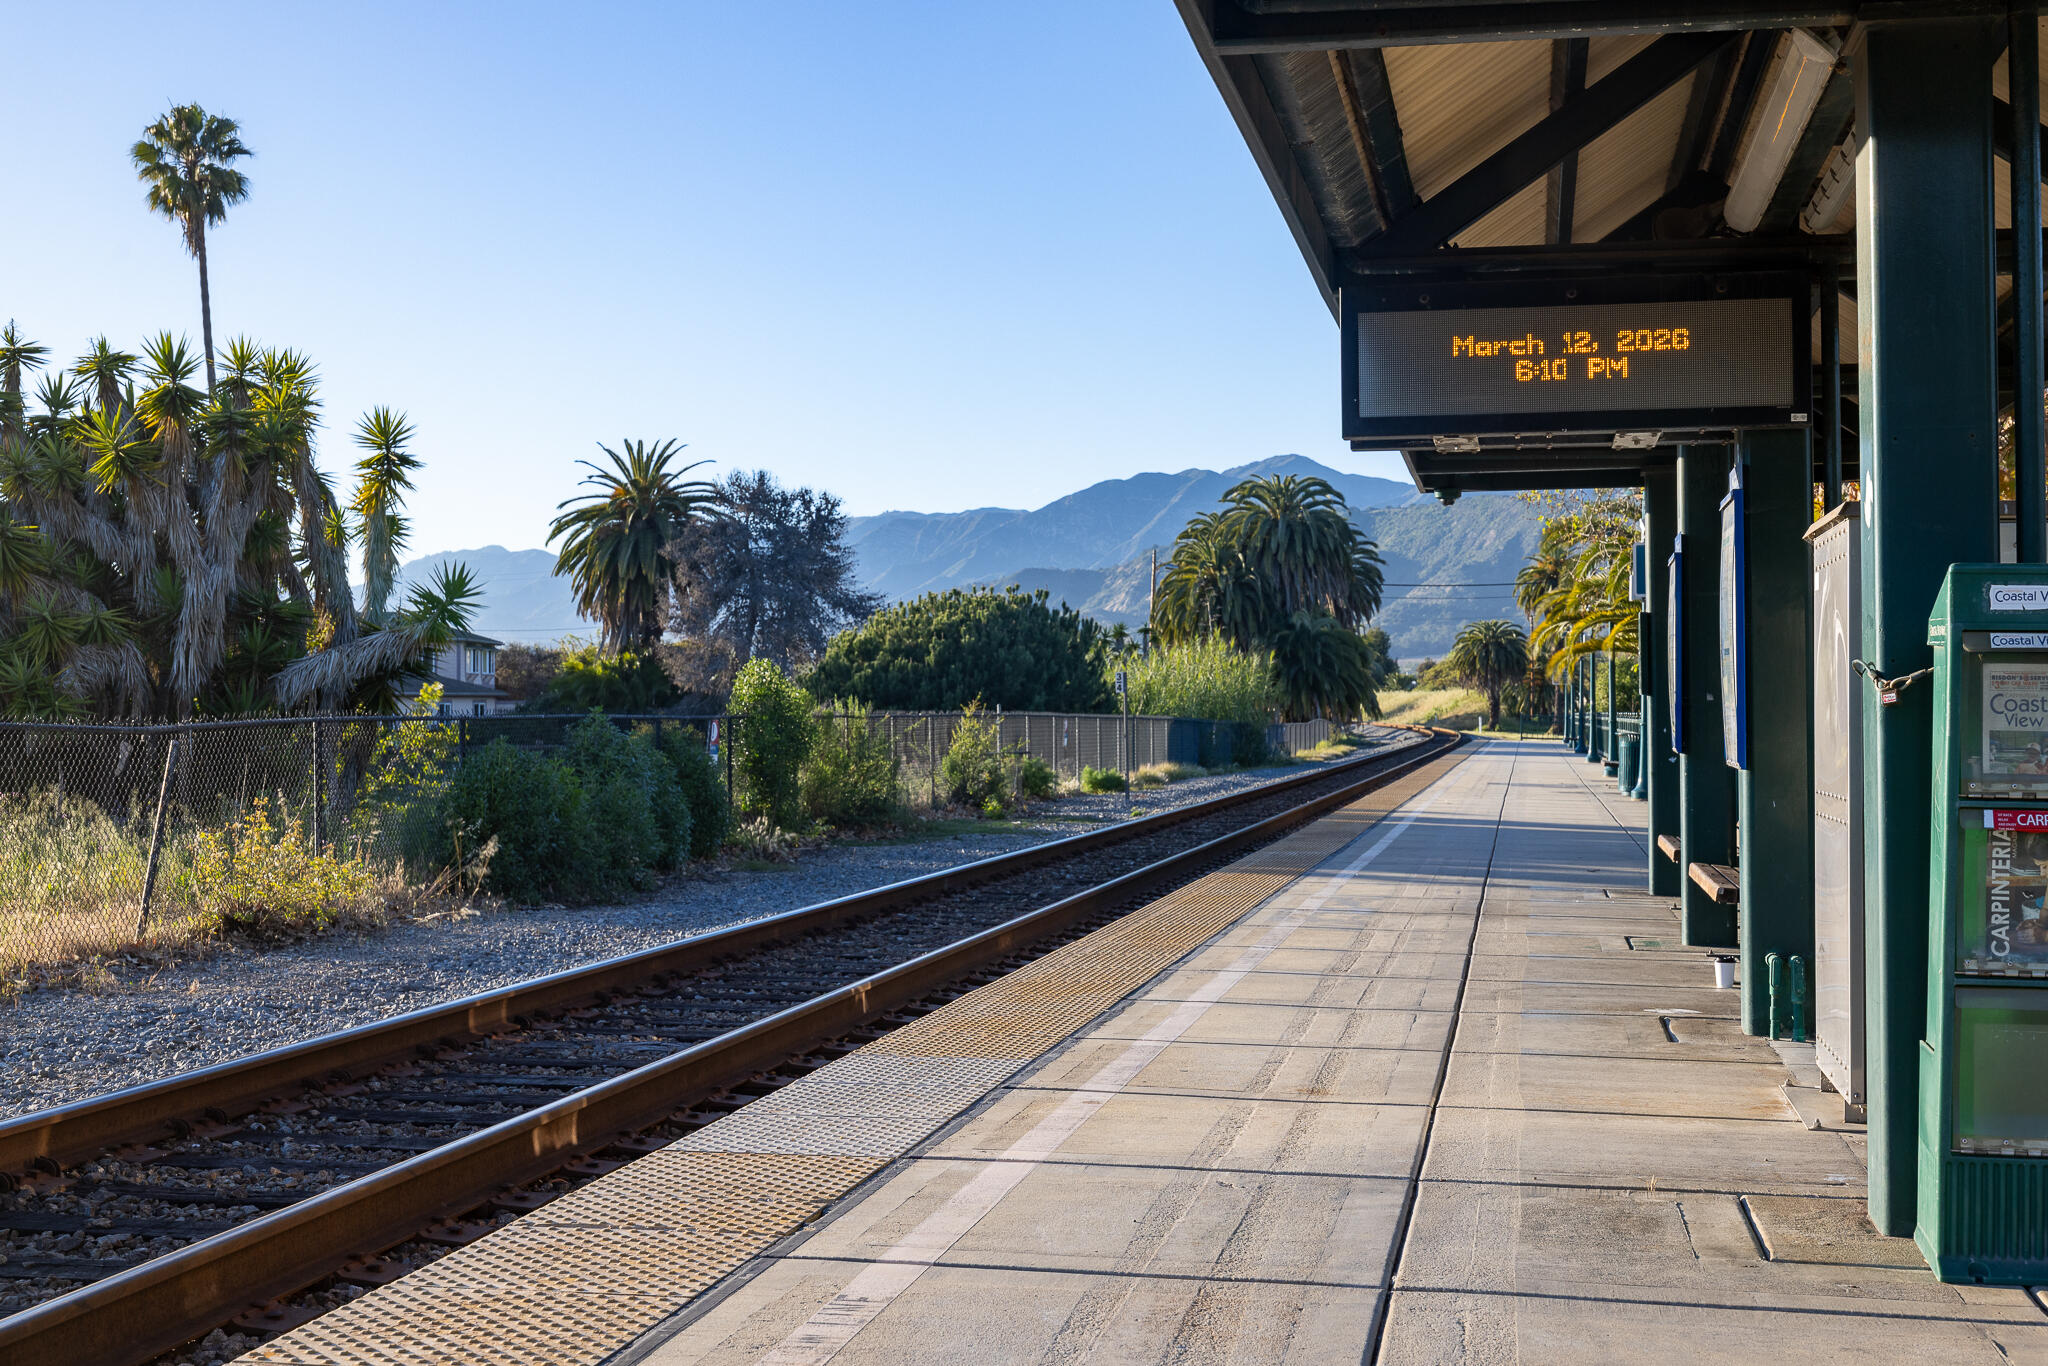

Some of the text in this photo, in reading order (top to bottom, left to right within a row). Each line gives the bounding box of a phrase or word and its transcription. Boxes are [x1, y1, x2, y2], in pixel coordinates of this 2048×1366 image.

[1452, 328, 1690, 357] March 12, 2026
[1515, 356, 1629, 382] 6:10 PM
[1995, 590, 2037, 603] Coastal
[1992, 635, 2034, 647] Coastal
[2004, 713, 2044, 728] View
[1990, 830, 2011, 957] CARPINTERIA
